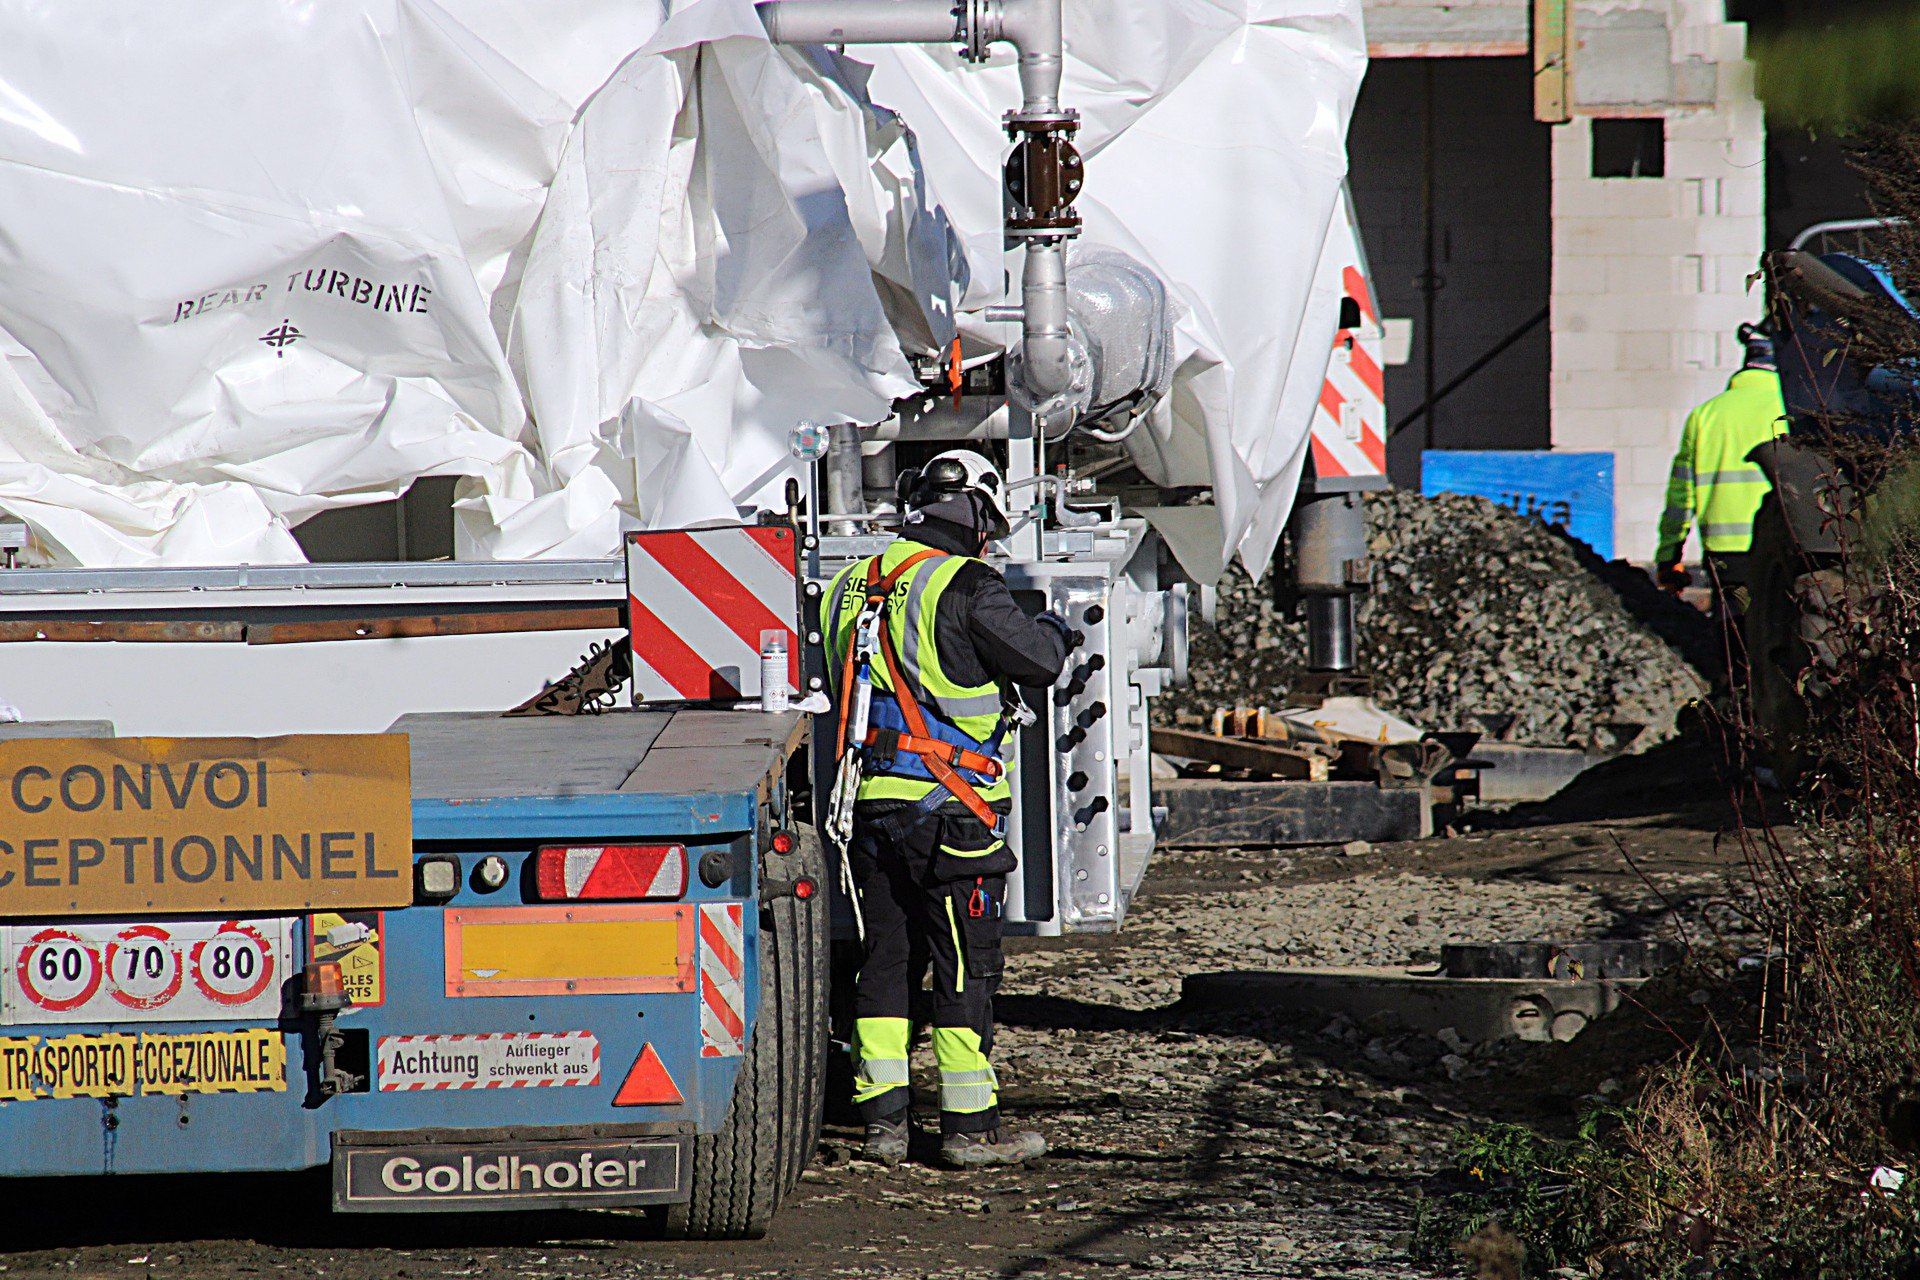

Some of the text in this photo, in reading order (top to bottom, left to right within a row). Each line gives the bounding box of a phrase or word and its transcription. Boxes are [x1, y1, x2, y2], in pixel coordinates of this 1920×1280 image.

[173, 269, 432, 323] REAR TURBINE
[844, 577, 909, 597] SIES
[11, 761, 268, 813] CONVOI
[39, 947, 82, 981] 60
[123, 946, 164, 980] 70
[212, 945, 254, 979] 80
[342, 974, 374, 986] GLES
[347, 986, 372, 998] RTS
[3, 1043, 126, 1091] TRASPORTO
[392, 1050, 479, 1079] Achtung
[506, 1043, 571, 1060] Auflieger
[489, 1062, 588, 1078] schwenkt aus
[381, 1152, 646, 1193] Goldhofer
